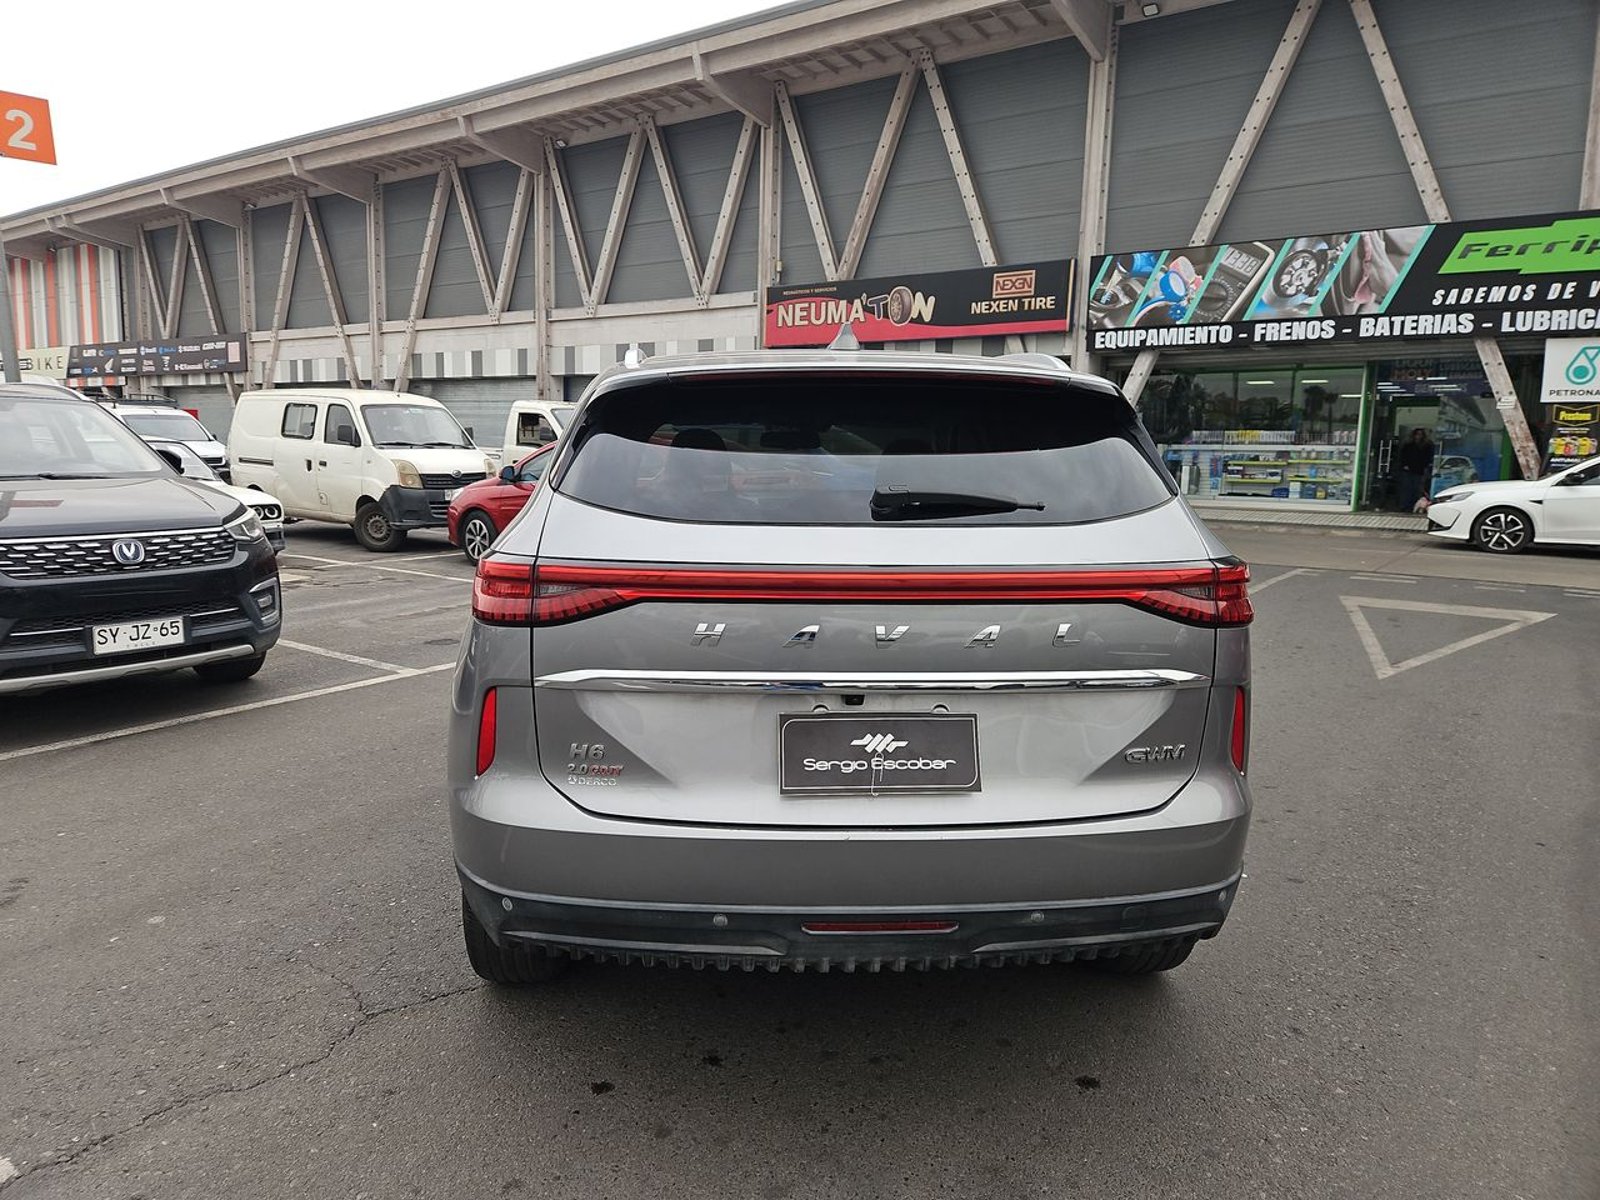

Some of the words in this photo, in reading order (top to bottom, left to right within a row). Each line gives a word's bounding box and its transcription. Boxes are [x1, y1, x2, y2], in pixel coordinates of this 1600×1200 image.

[5, 109, 37, 151] 2
[995, 276, 1033, 292] NEXEN
[1432, 284, 1537, 306] SABEMOS
[1547, 281, 1577, 300] DE
[971, 299, 1019, 314] NEXEN
[1022, 296, 1056, 311] TIRE
[1095, 324, 1233, 349] EQUIPAMIENTO
[1253, 320, 1336, 342] FRENOS
[1359, 313, 1475, 337] BATERIAS
[689, 622, 1081, 649] HAVAL
[569, 743, 605, 760] H6
[1124, 743, 1186, 764] GWM
[871, 757, 957, 770] Escobar
